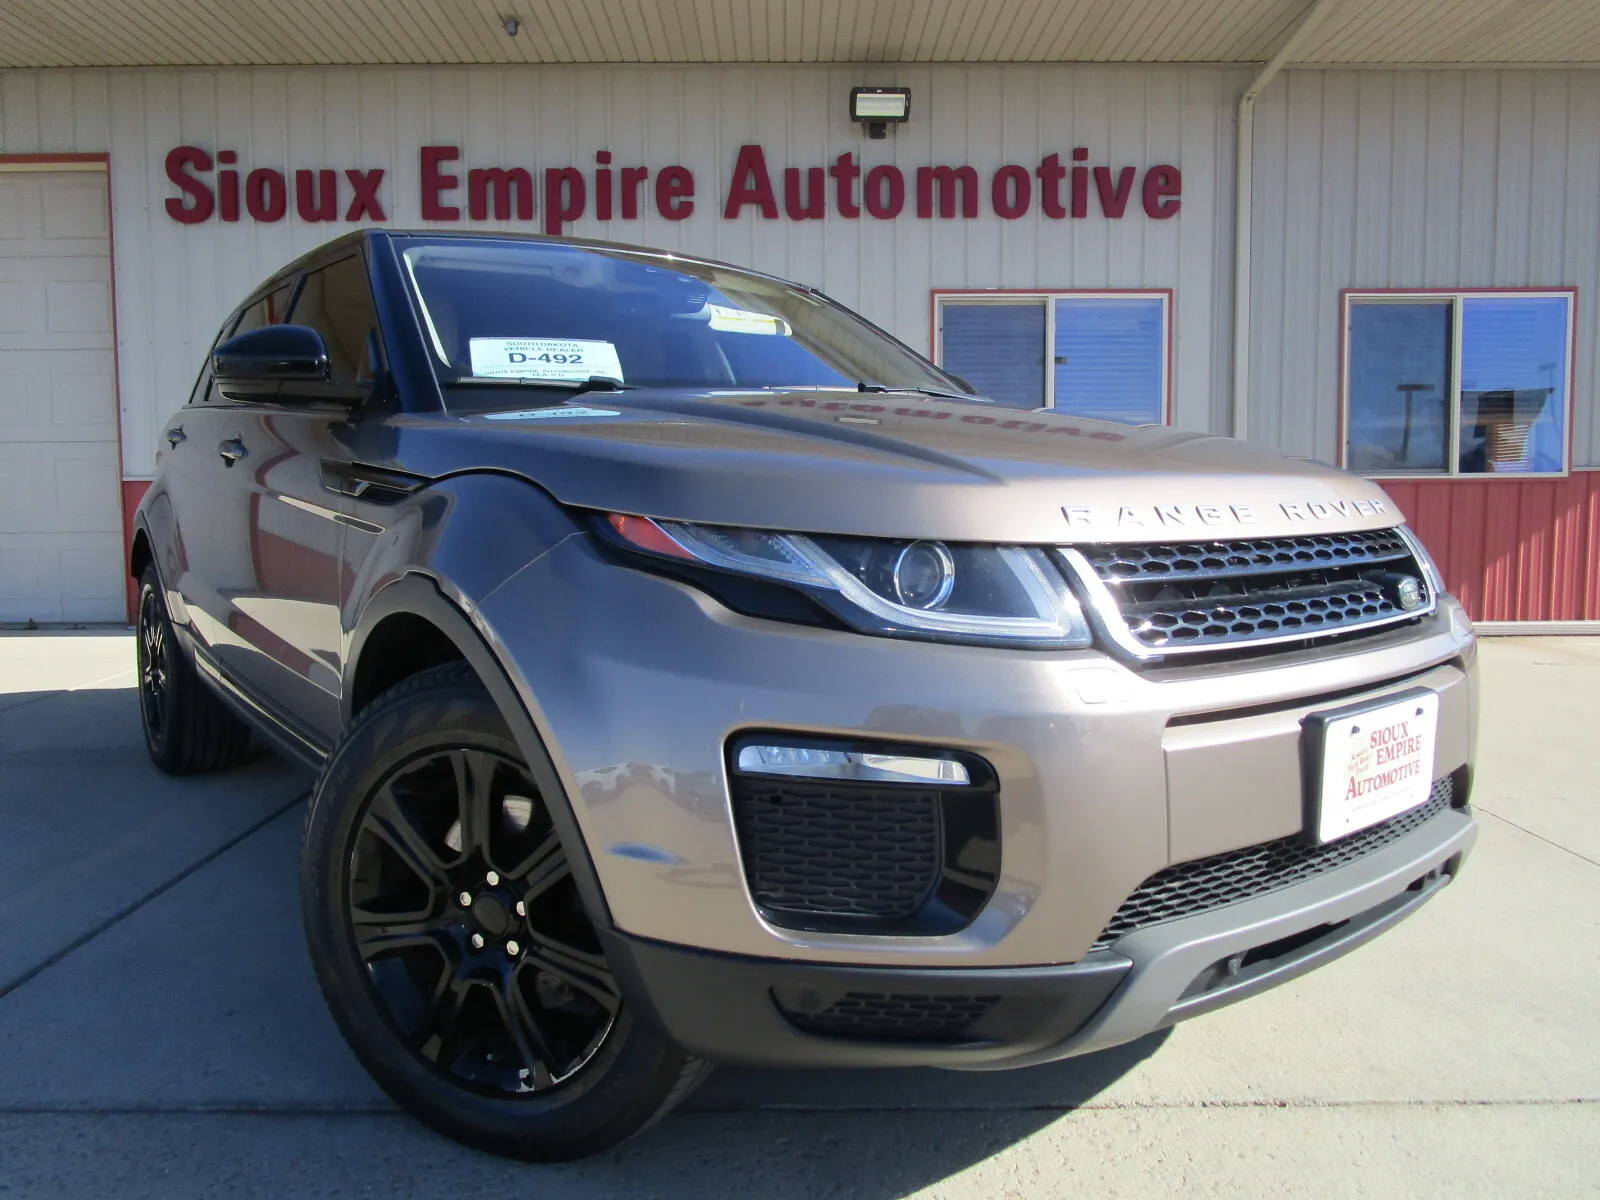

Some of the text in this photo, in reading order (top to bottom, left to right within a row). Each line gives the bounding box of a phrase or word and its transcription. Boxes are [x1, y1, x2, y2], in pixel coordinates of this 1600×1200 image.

[165, 145, 1182, 235] Sioux Empire Automotive
[508, 352, 583, 364] D-492
[1060, 499, 1388, 528] RANGE ROVER
[1370, 721, 1409, 749] SIOUX
[1376, 735, 1422, 766] EMPIRE
[1345, 759, 1421, 800] AUTOMOTIVE
